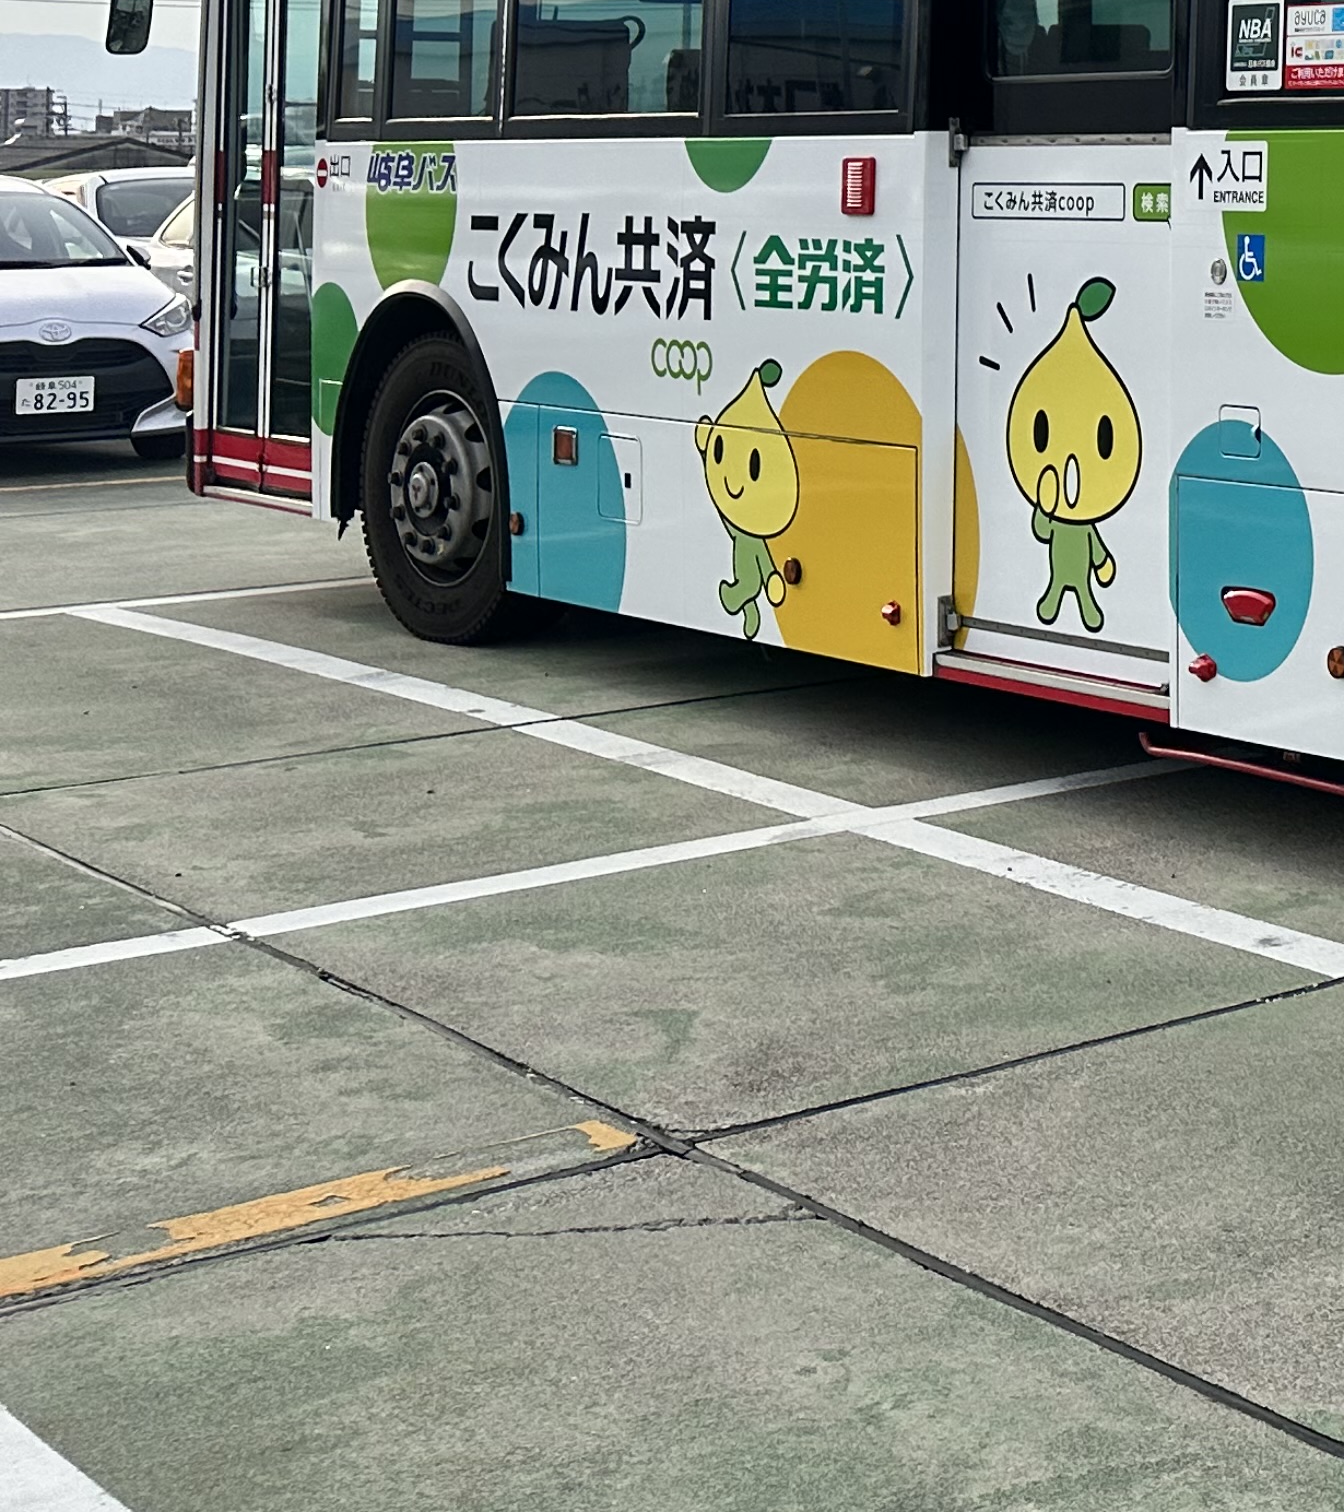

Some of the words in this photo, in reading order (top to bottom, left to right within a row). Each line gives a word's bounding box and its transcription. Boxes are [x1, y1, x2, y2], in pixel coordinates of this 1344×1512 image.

[1239, 18, 1272, 39] NBA
[1294, 9, 1326, 26] ayuca
[329, 154, 351, 178] 出口
[367, 150, 457, 192] 岐阜バス
[1217, 150, 1264, 182] 入口
[983, 191, 1095, 216] こくみん共済coop
[1213, 190, 1264, 204] ENTRANCE
[467, 213, 717, 320] こくみん共済
[651, 337, 712, 396] coop
[33, 390, 89, 411] 82-95
